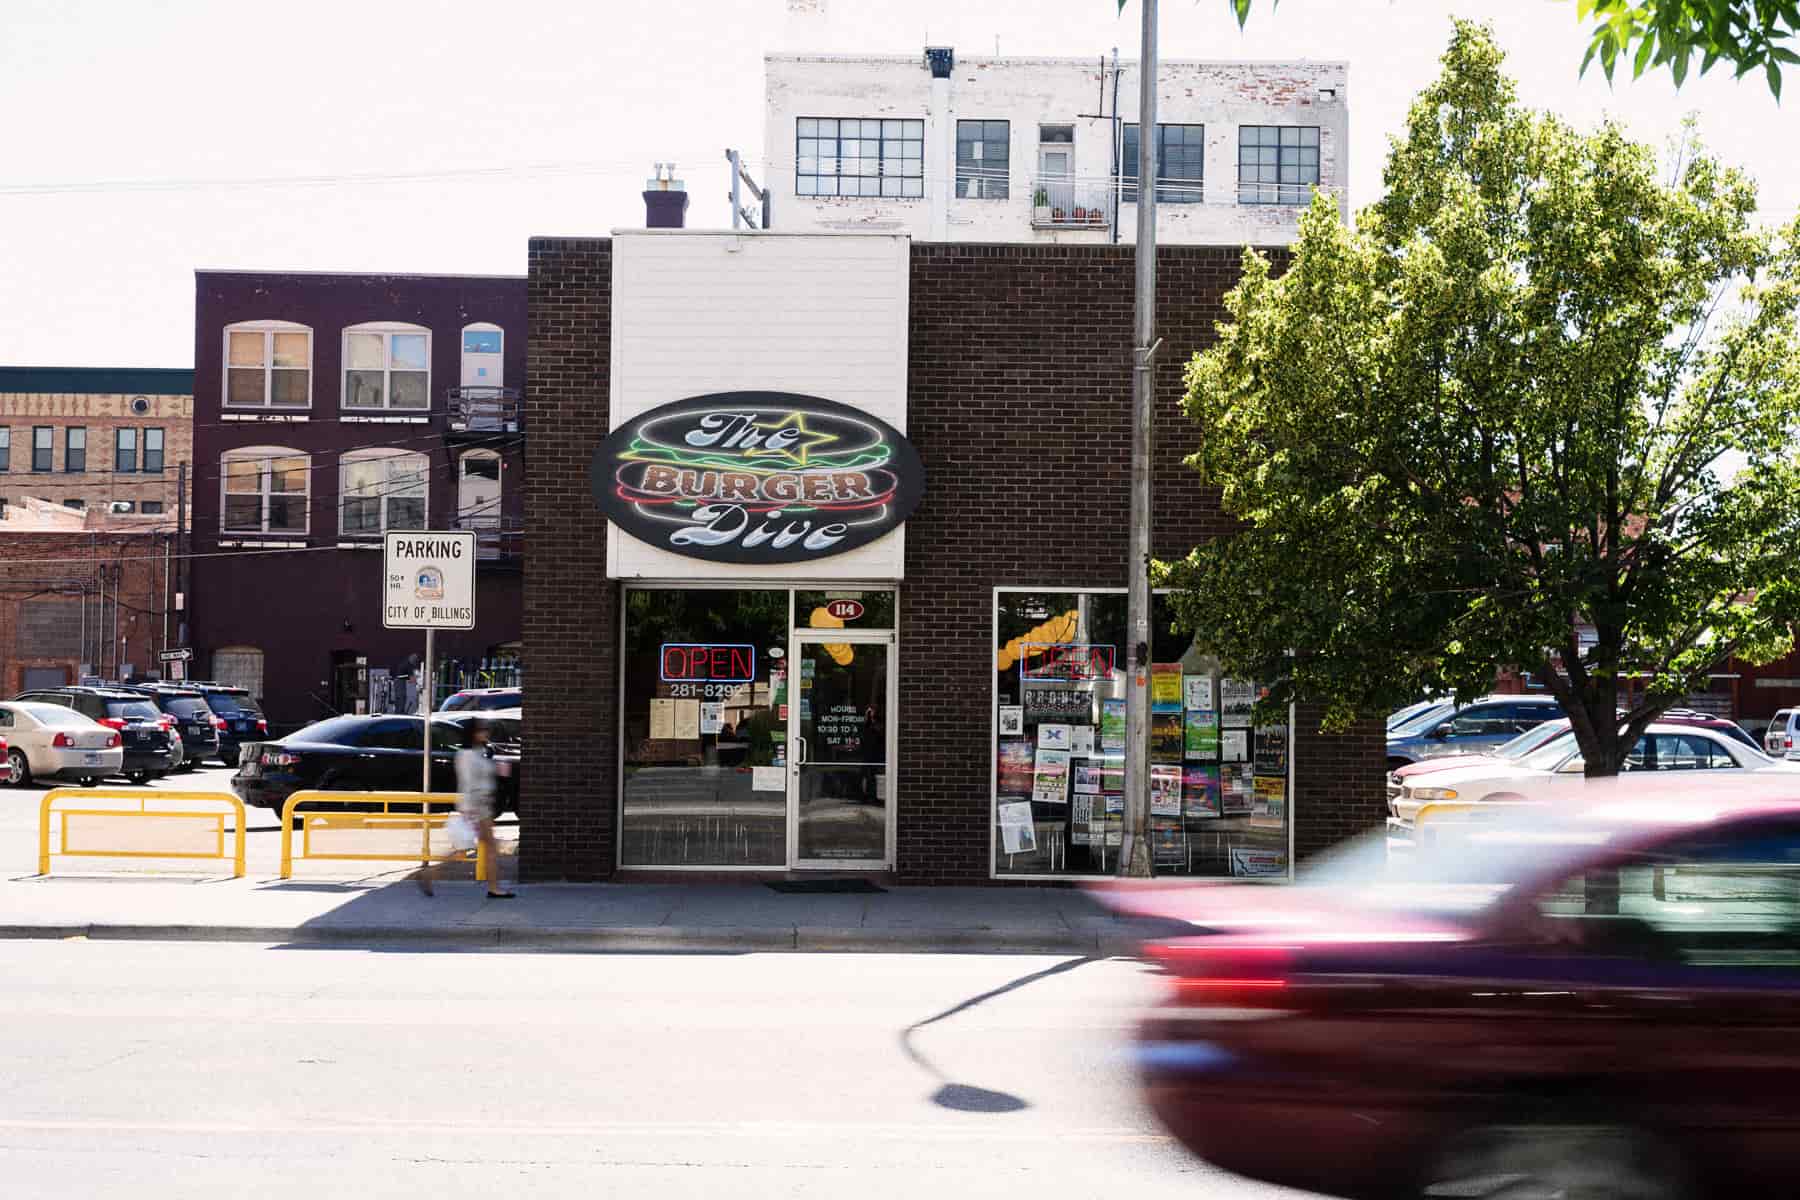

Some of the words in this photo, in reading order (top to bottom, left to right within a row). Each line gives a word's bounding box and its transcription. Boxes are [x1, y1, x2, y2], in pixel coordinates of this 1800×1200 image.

[685, 412, 800, 450] The
[641, 465, 874, 501] BURGER
[670, 503, 849, 550] Dive
[396, 540, 462, 559] PARKING
[387, 606, 409, 618] CITY
[414, 606, 426, 619] OF
[431, 606, 471, 620] BILLINGS
[835, 604, 855, 616] 114
[664, 647, 752, 678] OPEN
[1023, 645, 1114, 679] OPEN
[671, 683, 744, 697] 281-8292
